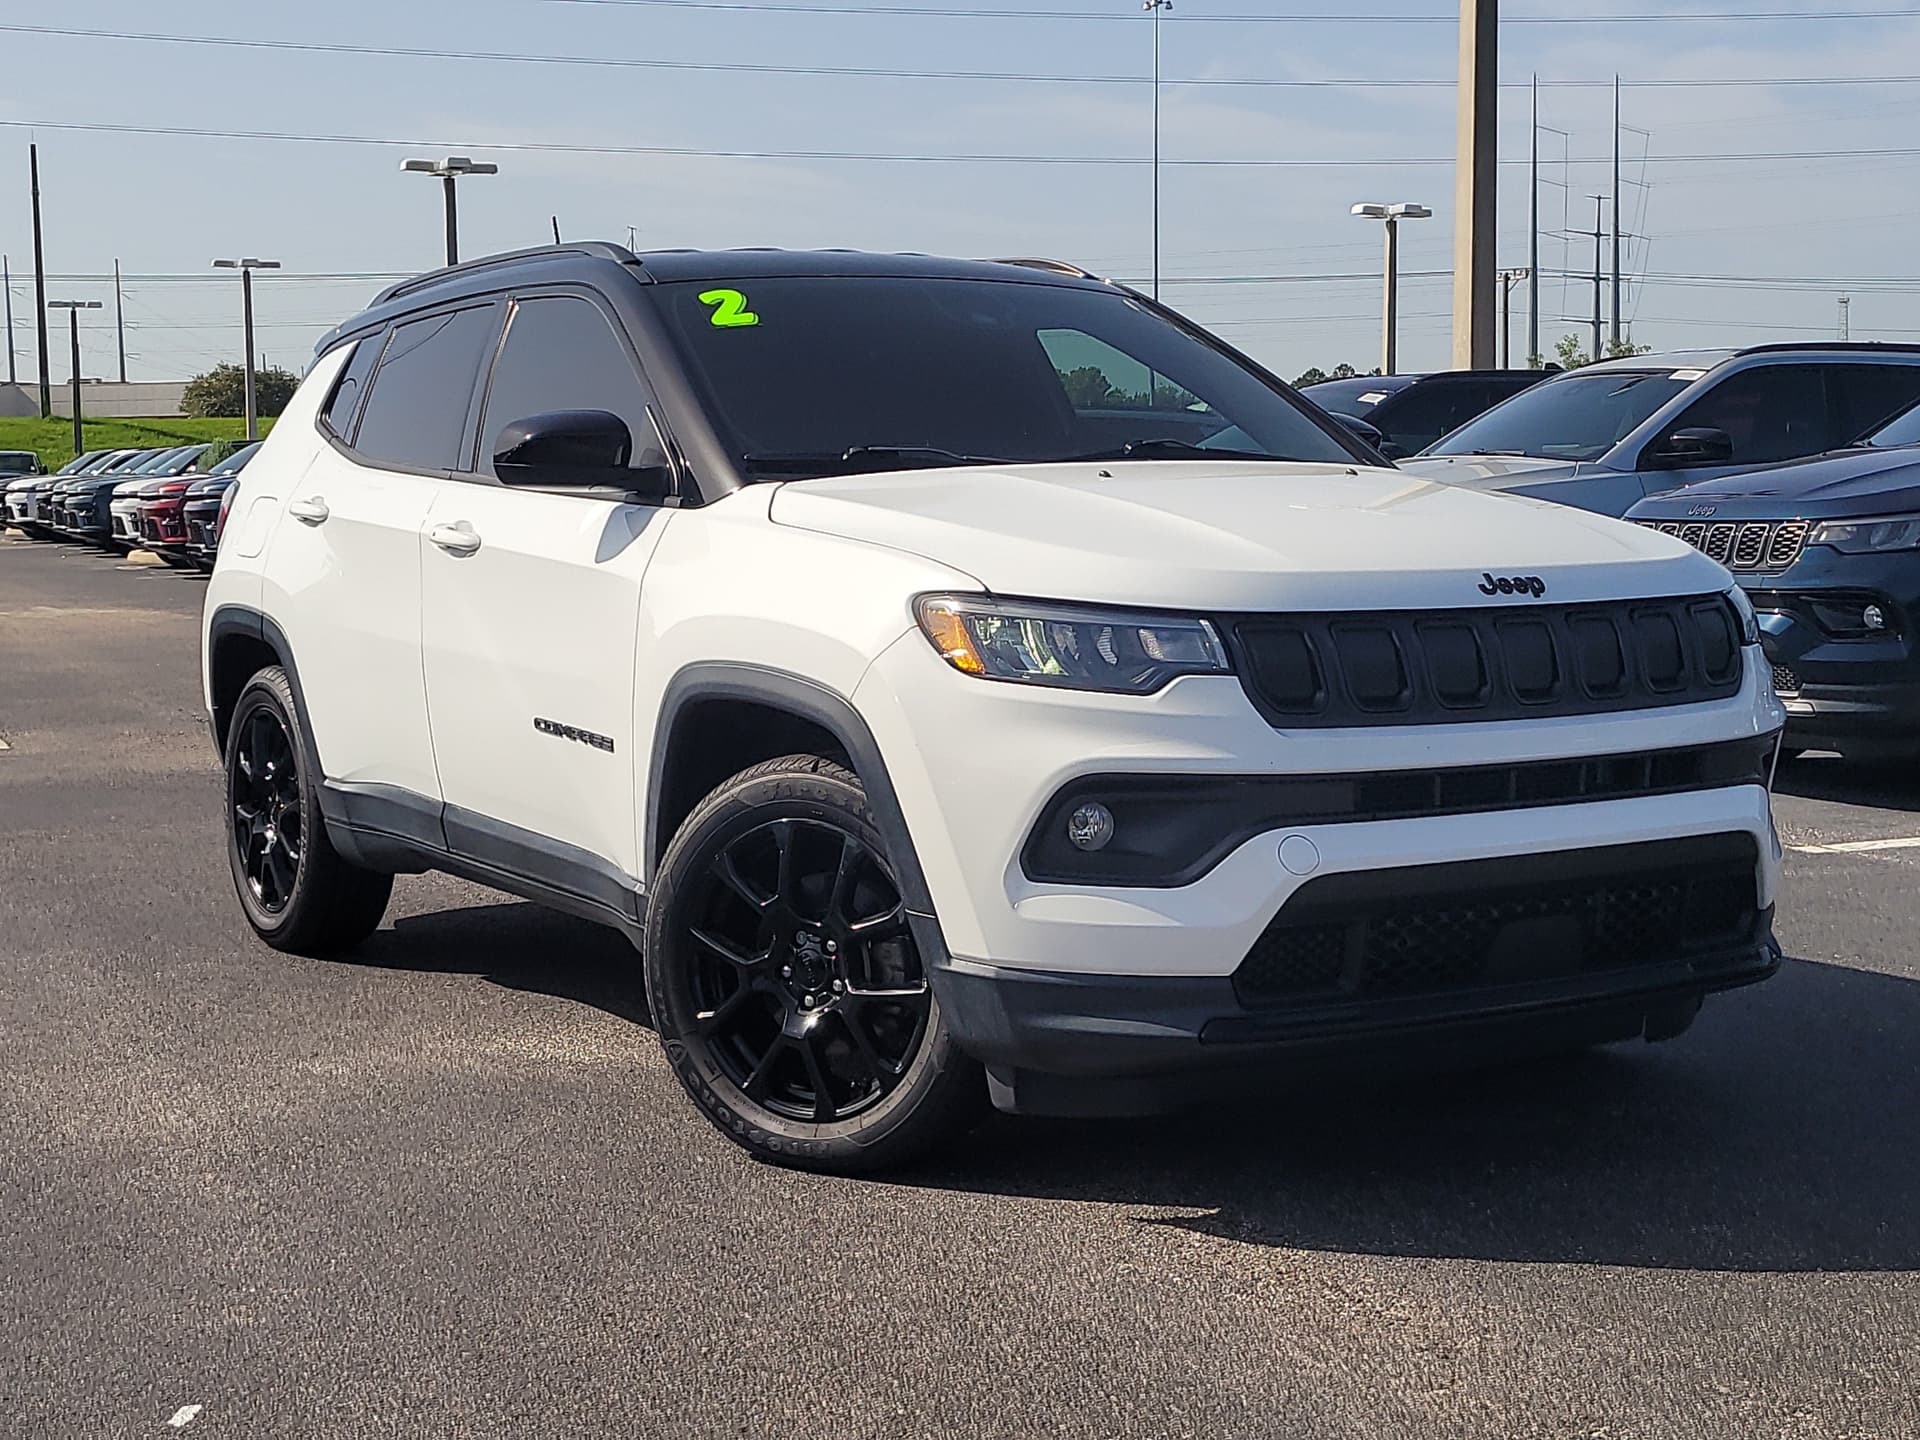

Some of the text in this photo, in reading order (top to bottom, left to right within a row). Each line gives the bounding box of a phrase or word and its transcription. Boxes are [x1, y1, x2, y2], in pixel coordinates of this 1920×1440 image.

[698, 288, 760, 327] 2
[1687, 504, 1717, 518] Jeep
[1478, 572, 1546, 598] Jeep
